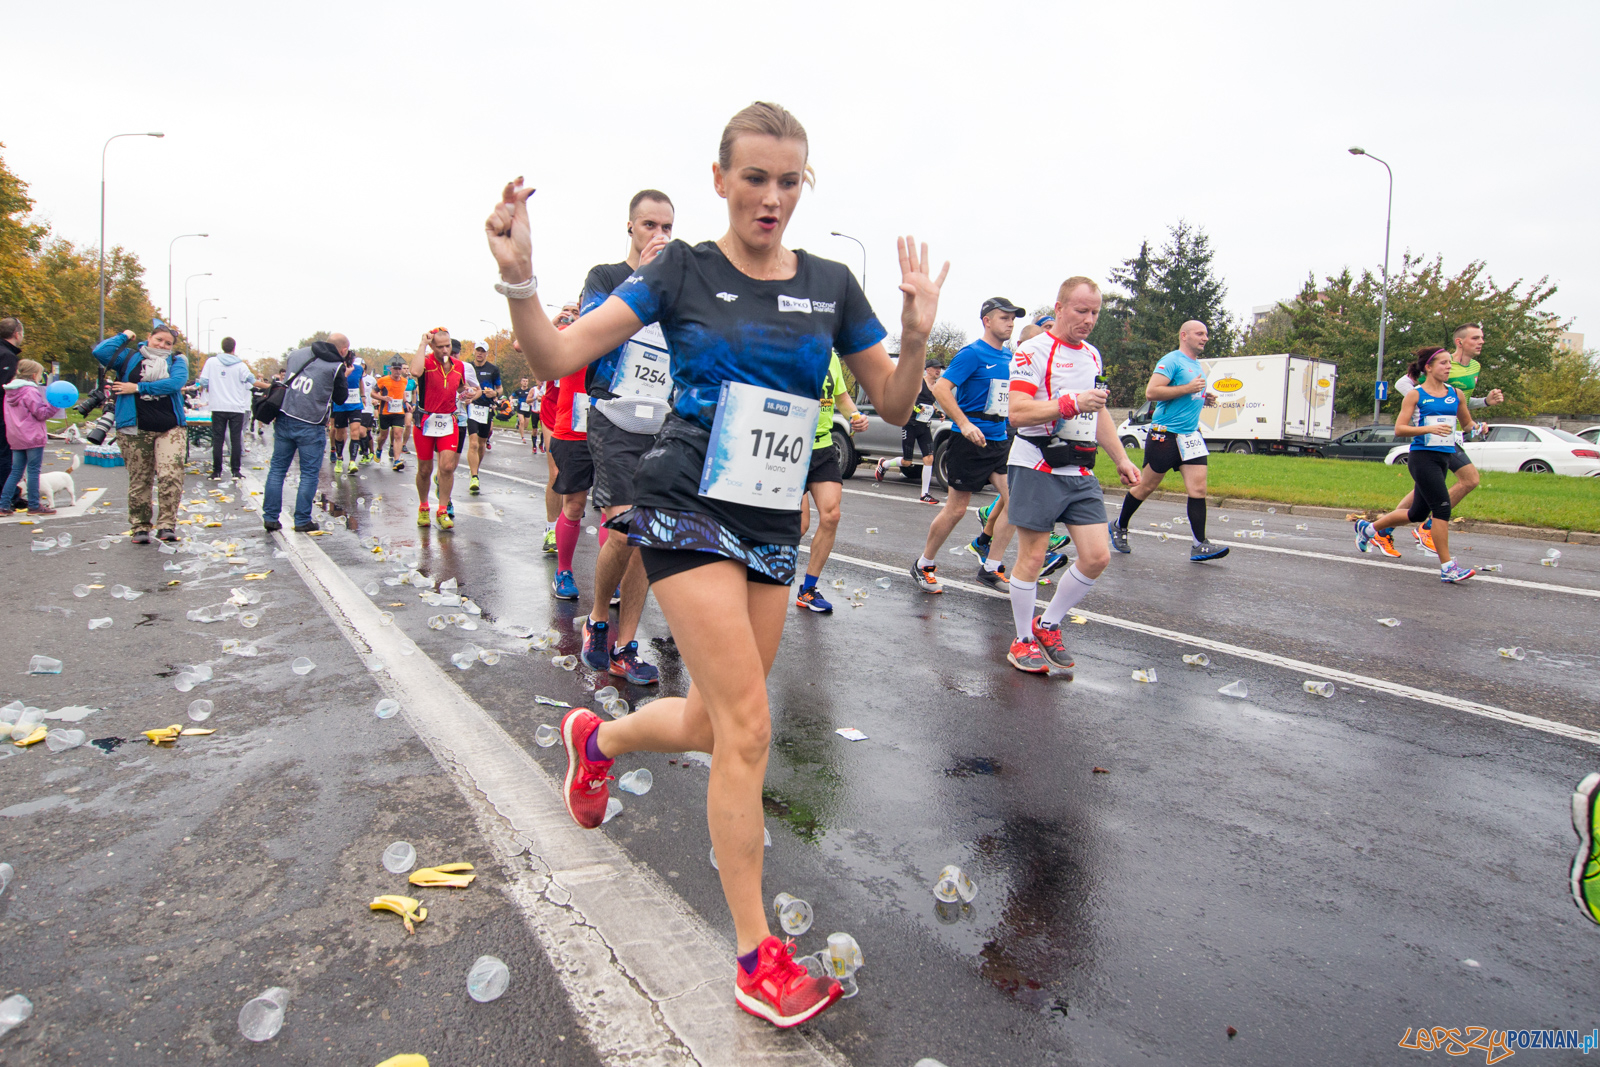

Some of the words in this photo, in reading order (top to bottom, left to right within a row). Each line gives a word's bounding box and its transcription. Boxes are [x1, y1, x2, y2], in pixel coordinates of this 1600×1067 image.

[715, 291, 739, 302] 4F
[634, 364, 666, 386] 1254
[1216, 381, 1240, 389] Fawor
[766, 401, 776, 410] 18.
[775, 403, 789, 413] PKO
[434, 420, 448, 429] 109
[750, 428, 804, 465] 1140
[1184, 439, 1202, 449] 3506
[765, 462, 787, 473] Iwona
